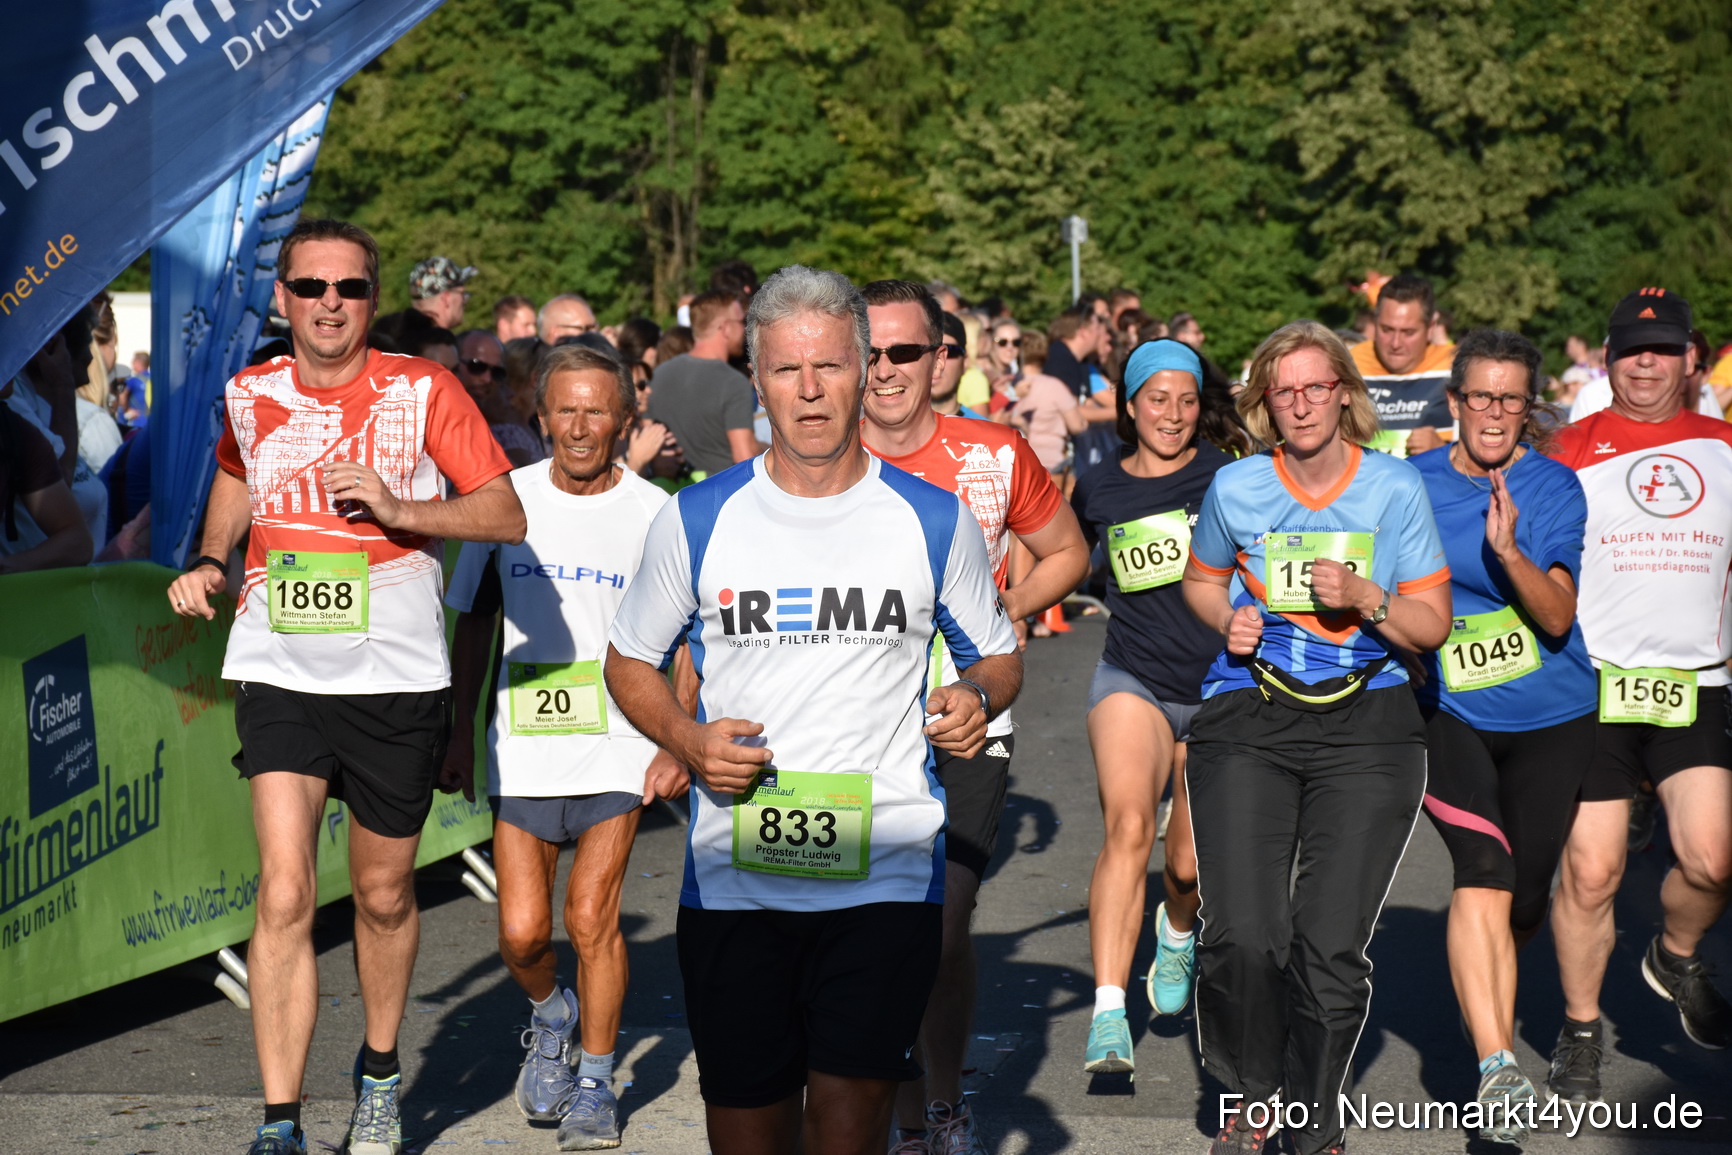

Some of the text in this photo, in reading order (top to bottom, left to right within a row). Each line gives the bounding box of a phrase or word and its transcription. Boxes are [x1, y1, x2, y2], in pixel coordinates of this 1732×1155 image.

[221, 0, 321, 71] Druc
[1375, 400, 1428, 414] scher
[276, 450, 308, 461] 26.22
[964, 459, 1000, 471] 91.62%
[1601, 530, 1724, 547] LAUFEN MIT HERZ
[1117, 538, 1181, 573] 1063
[1613, 550, 1627, 558] Dr.
[1631, 548, 1656, 557] Heck
[1667, 549, 1680, 557] Dr.
[1683, 549, 1712, 560] Röschl
[511, 562, 624, 590] DELPHI
[1128, 569, 1152, 579] Schmid
[1614, 561, 1711, 574] Leistungsdiagnostik
[277, 581, 353, 610] 1868
[275, 618, 301, 626] Sparkasse
[280, 611, 347, 619] Wittmann Stefan
[727, 634, 904, 650] Leading FILTER Technology
[1453, 632, 1523, 669] 1049
[1467, 661, 1518, 678] Gradl Brigitte
[1615, 677, 1684, 707] 1565
[536, 689, 571, 715] 20
[40, 692, 82, 732] Fischer
[45, 718, 81, 746] AUTOMOBILE
[985, 750, 1010, 758] adidas
[800, 796, 826, 805] 2018
[0, 738, 164, 914] firmenlauf
[759, 807, 837, 848] 833
[756, 844, 841, 863] Pröpster Ludwig
[763, 856, 831, 868] IREMA-Filter GmbH
[3, 880, 77, 950] neumarkt
